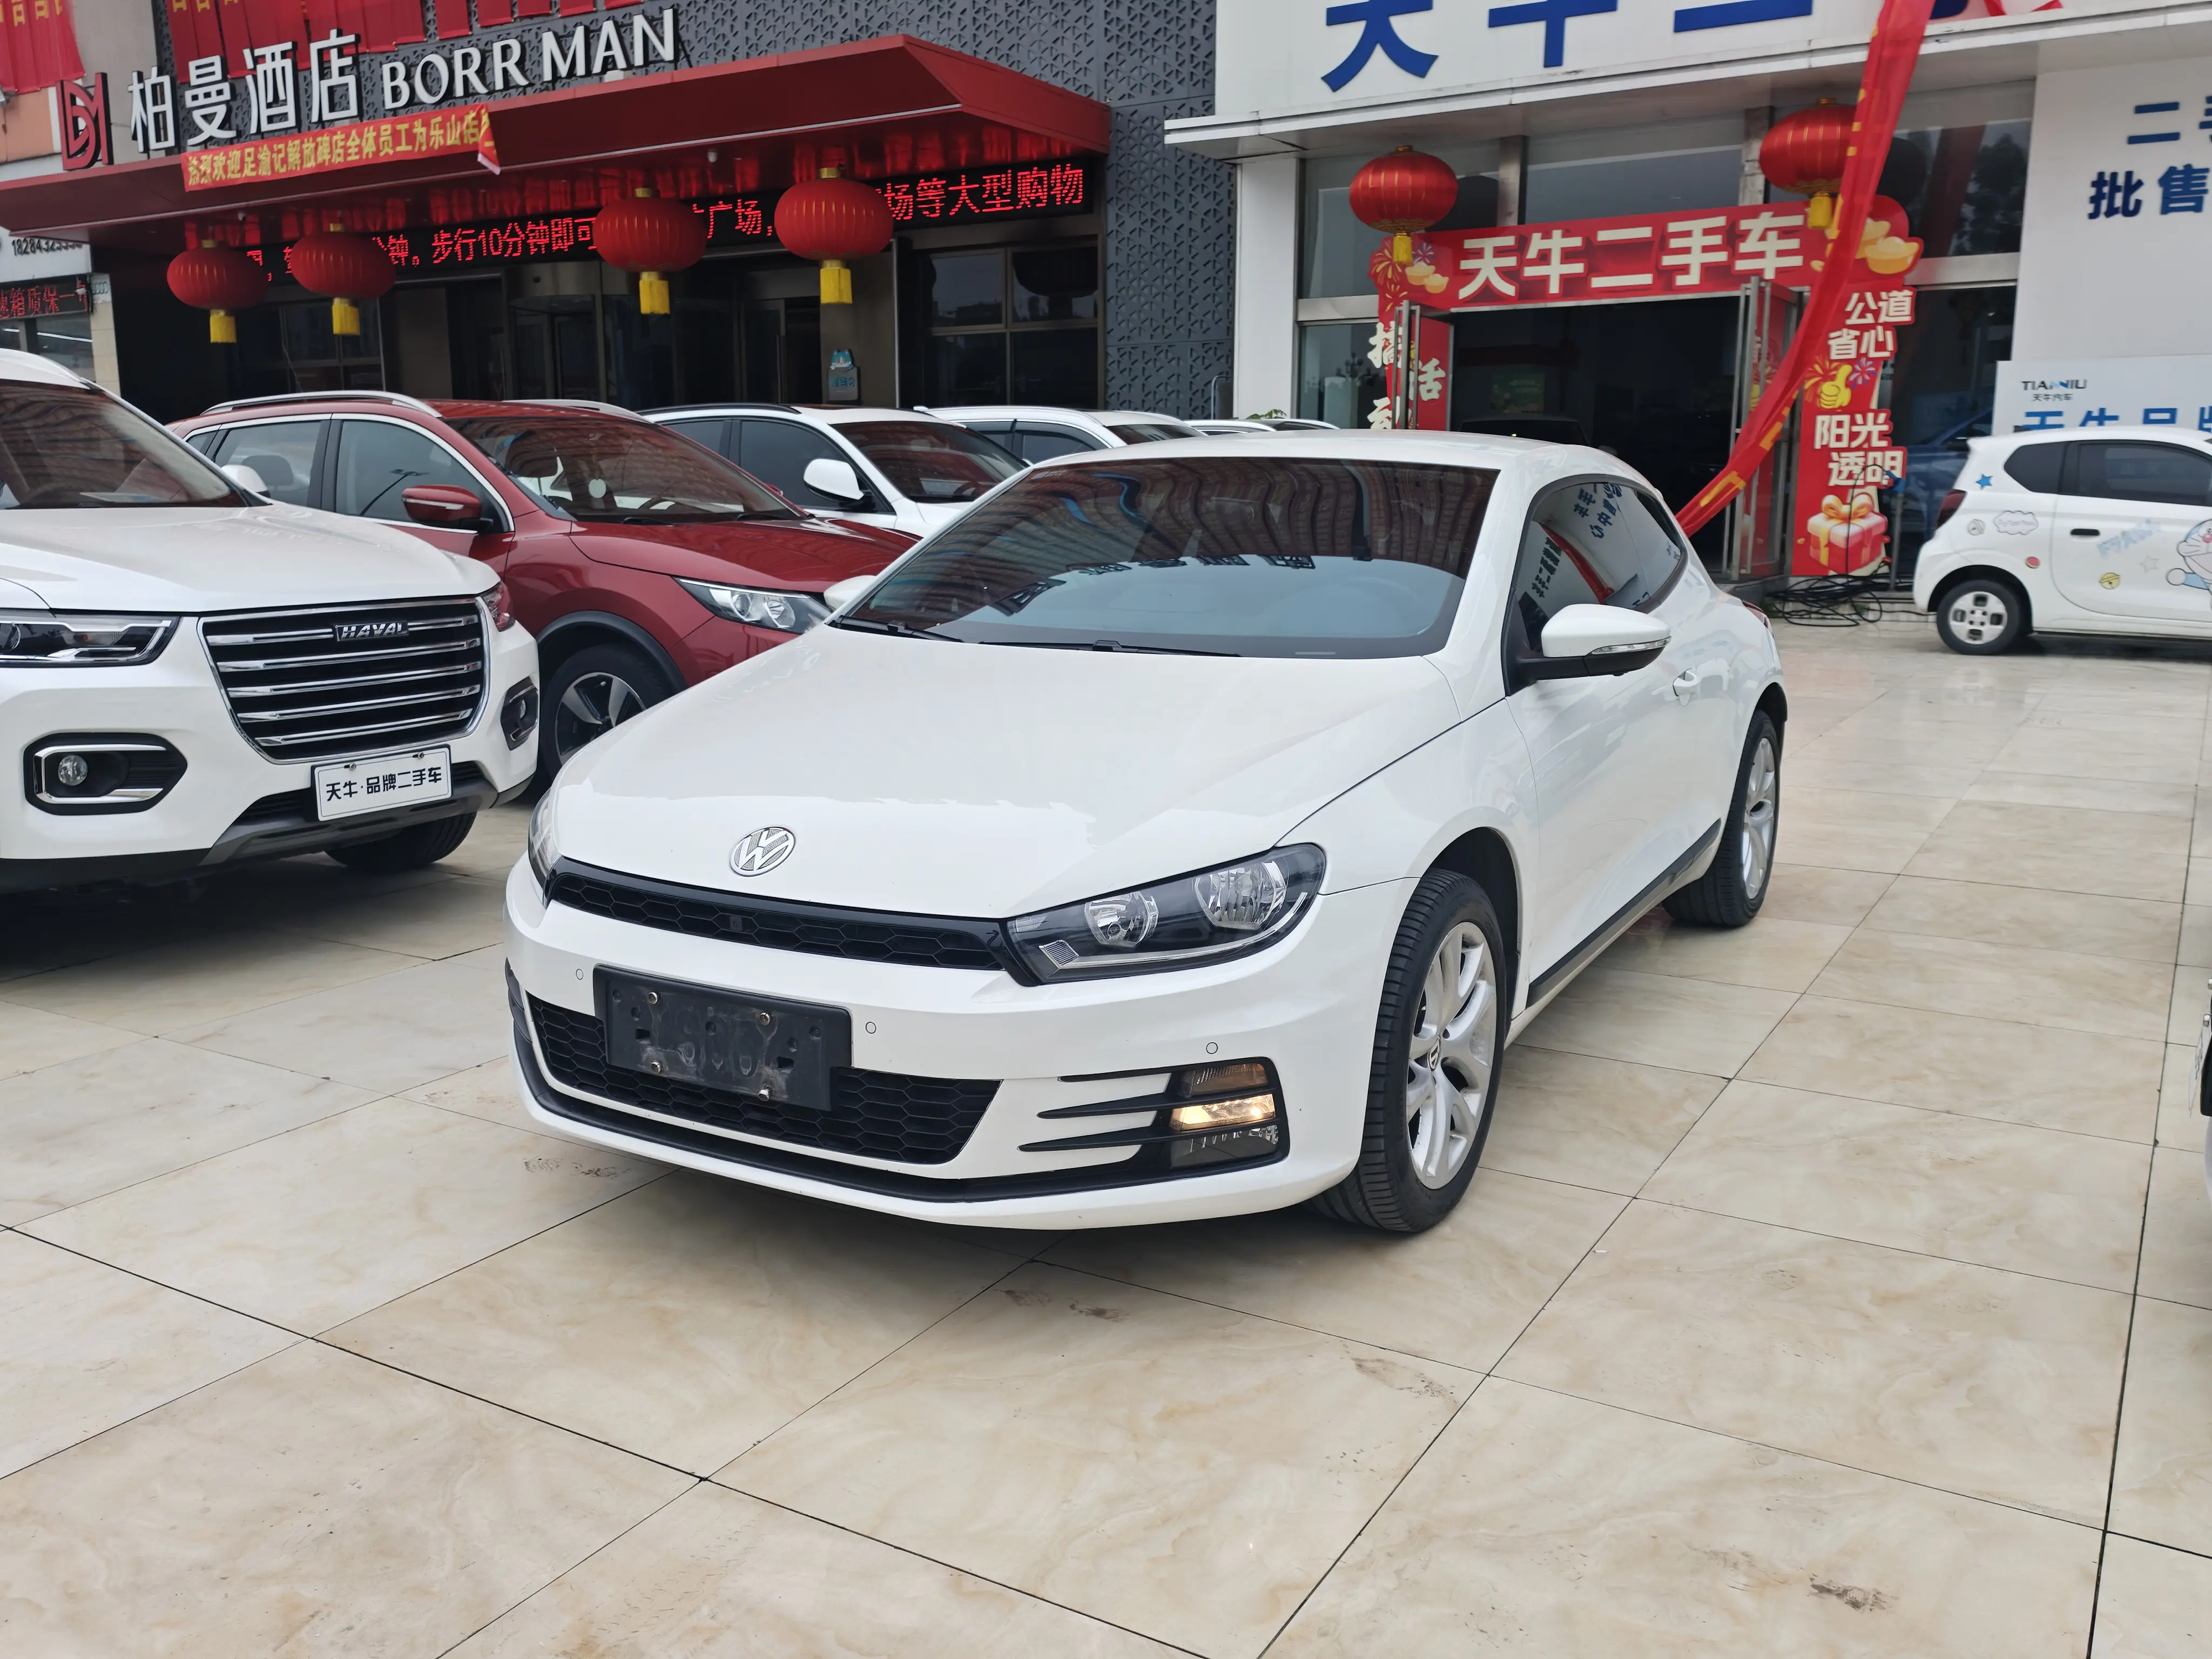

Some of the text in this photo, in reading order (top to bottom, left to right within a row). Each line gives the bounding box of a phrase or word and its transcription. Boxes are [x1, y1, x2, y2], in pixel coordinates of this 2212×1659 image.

[127, 29, 358, 153] 柏曼酒店
[2088, 164, 2210, 219] 批售
[1458, 212, 1804, 300] 天牛二手车
[1845, 289, 1913, 325] 公道
[1827, 325, 1894, 360] 省心
[1814, 412, 1889, 449] 阳光
[1827, 450, 1904, 487] 透明
[341, 623, 408, 639] HAVAL
